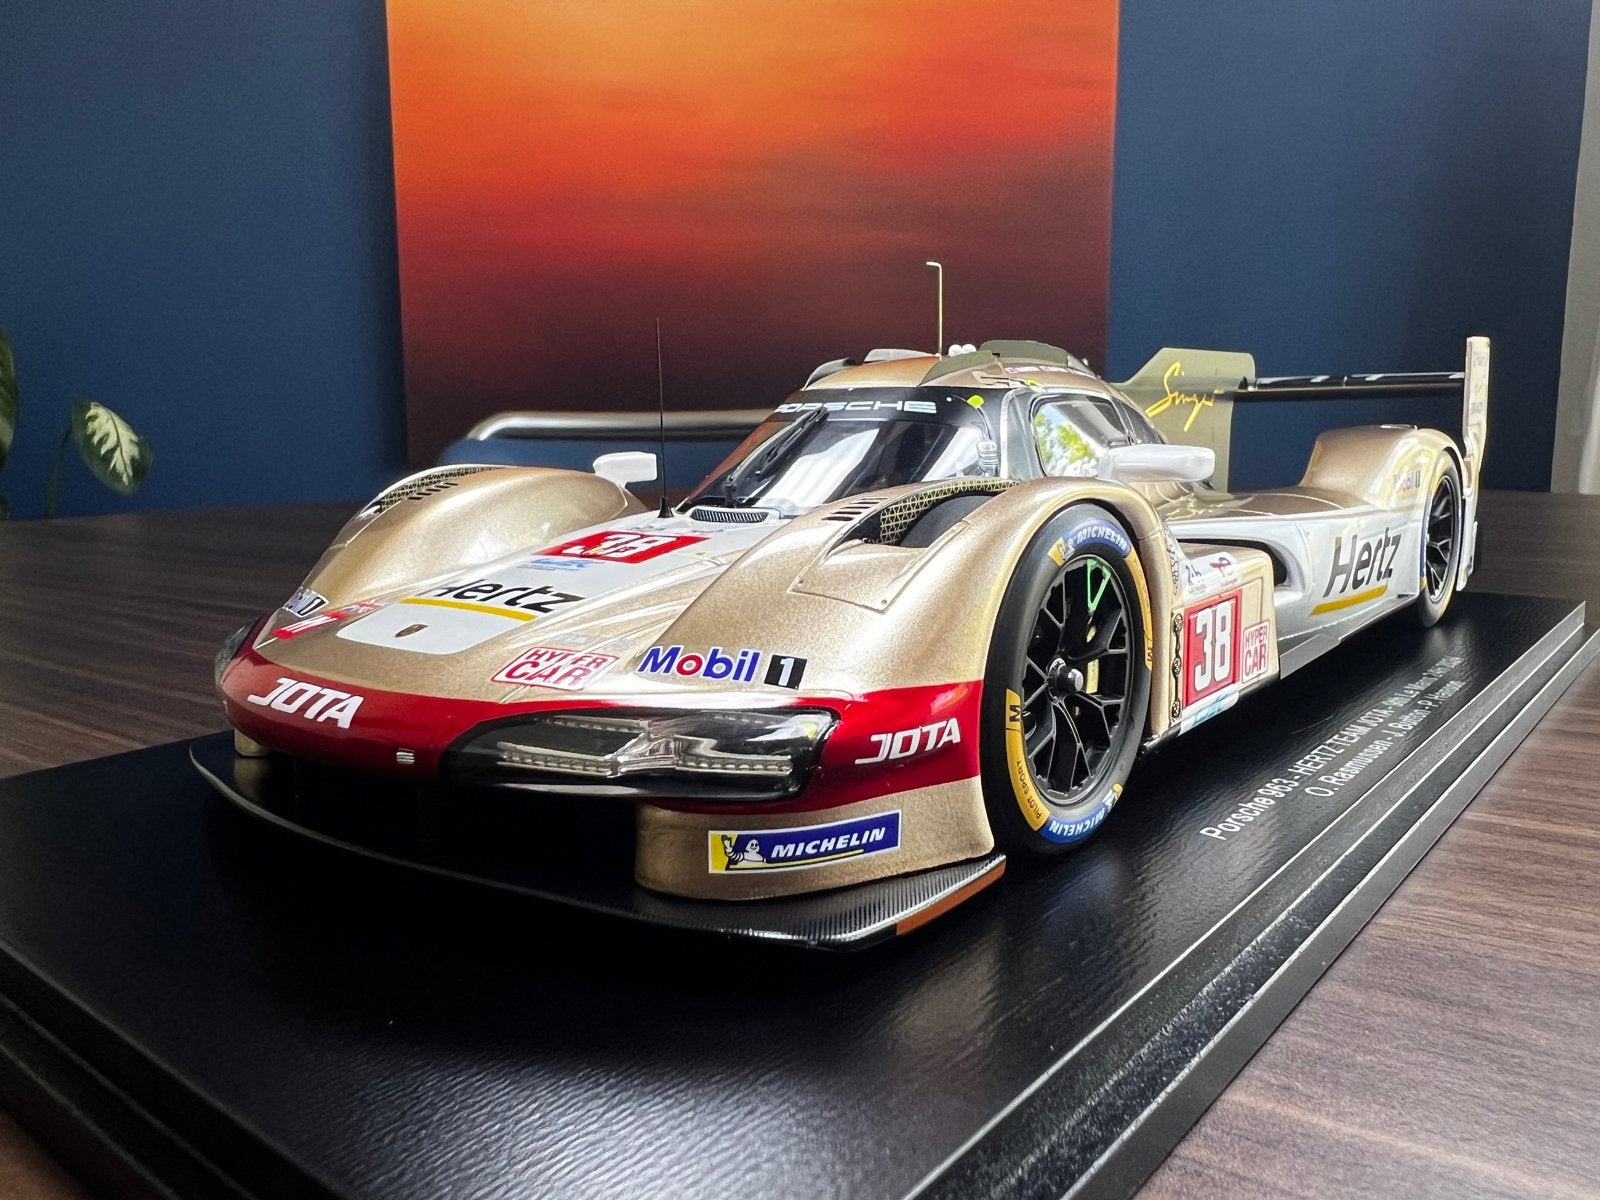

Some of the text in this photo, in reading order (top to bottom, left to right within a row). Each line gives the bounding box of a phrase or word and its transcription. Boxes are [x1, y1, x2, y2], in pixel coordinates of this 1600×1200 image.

[1076, 525, 1127, 551] MICHELIN
[1322, 527, 1402, 598] Hertz
[415, 579, 587, 614] Hertz
[1194, 600, 1232, 692] 38
[1244, 626, 1268, 650] HYPER
[504, 660, 593, 687] CAR
[638, 646, 760, 683] Mobil
[1243, 644, 1267, 677] CAR
[247, 677, 364, 728] JOTA
[854, 717, 962, 764] JOTA
[1381, 729, 1407, 737] J.
[1200, 797, 1276, 840] Porsche
[1257, 778, 1299, 797] 963
[1287, 745, 1345, 775] HERTZ
[1326, 725, 1372, 746] TEAM
[1356, 709, 1394, 726] JOTA
[1318, 740, 1394, 785] Rasmussen
[1016, 760, 1042, 819] PILOT SPORT
[1304, 786, 1340, 797] O.
[1049, 808, 1105, 836] MICHELIN
[770, 826, 887, 859] MICHELIN
